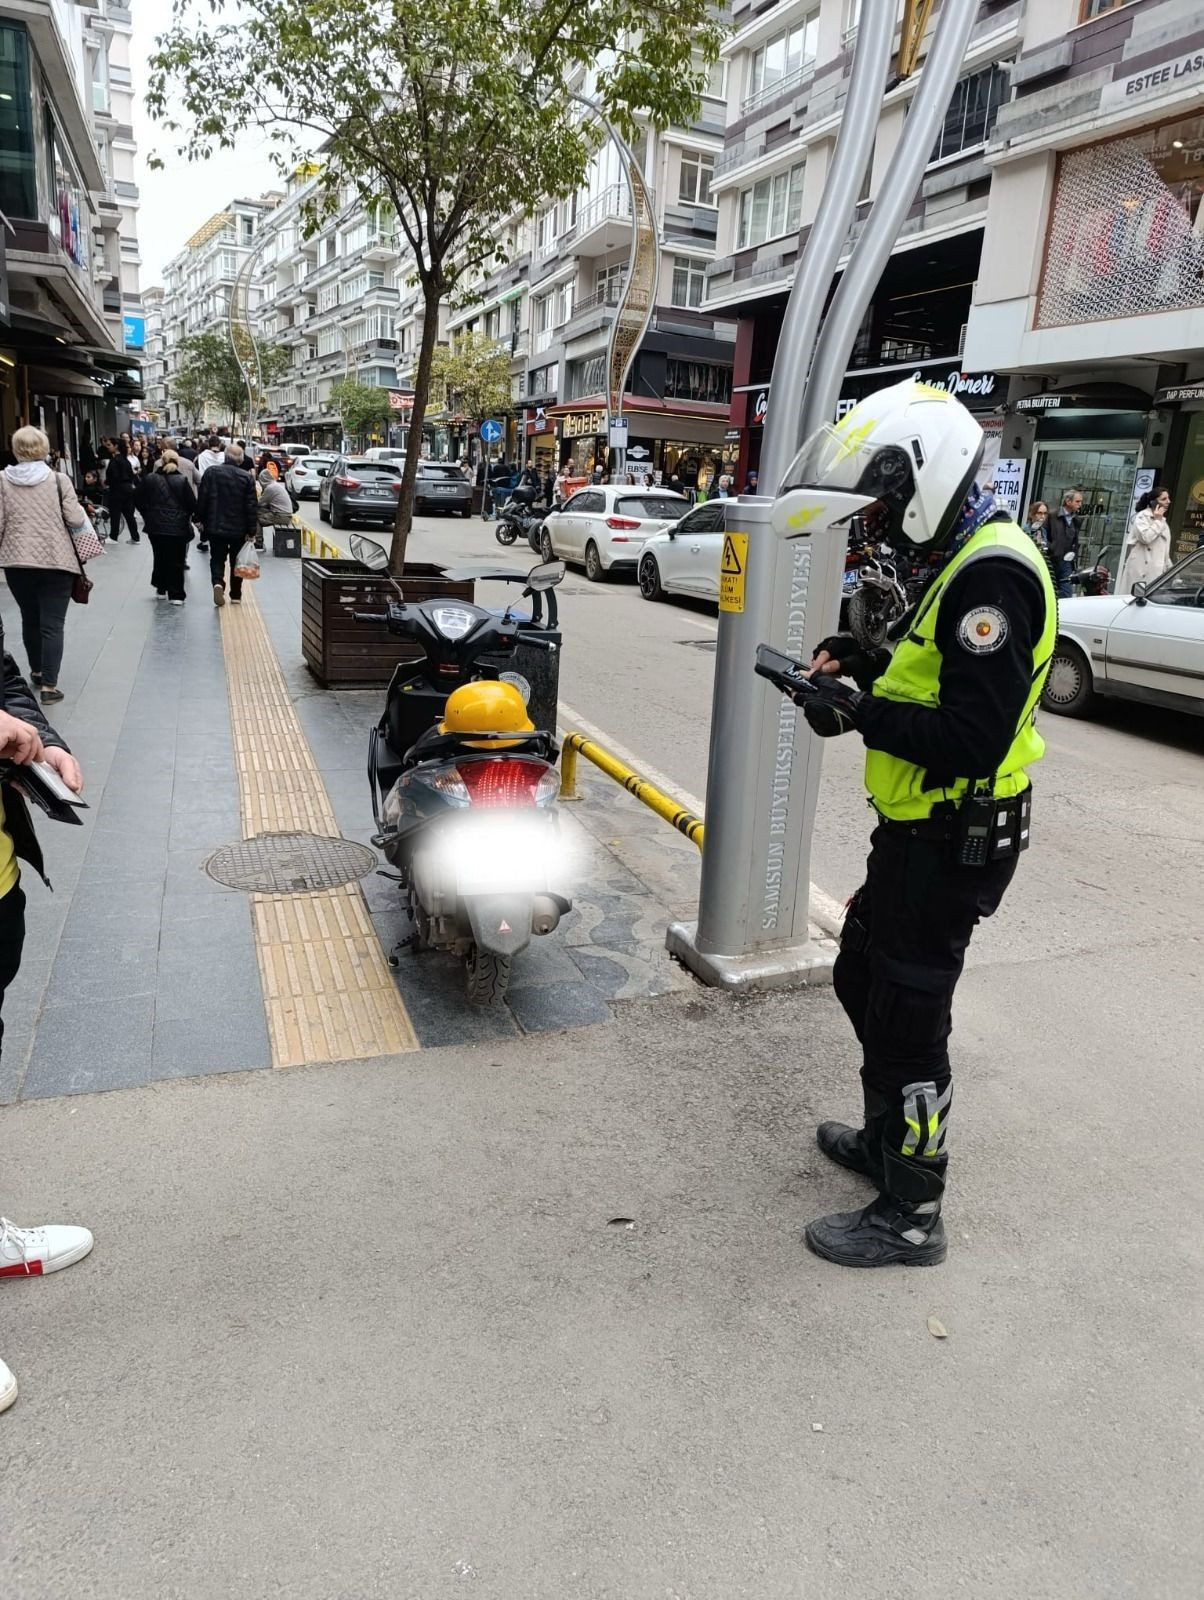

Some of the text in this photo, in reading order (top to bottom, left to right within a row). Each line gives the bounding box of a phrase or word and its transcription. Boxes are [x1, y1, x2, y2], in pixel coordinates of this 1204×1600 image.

[1126, 55, 1204, 95] ESTEE LAS
[1016, 399, 1031, 409] PETRA
[993, 480, 1020, 496] PETRA
[762, 840, 785, 929] SAMSUN
